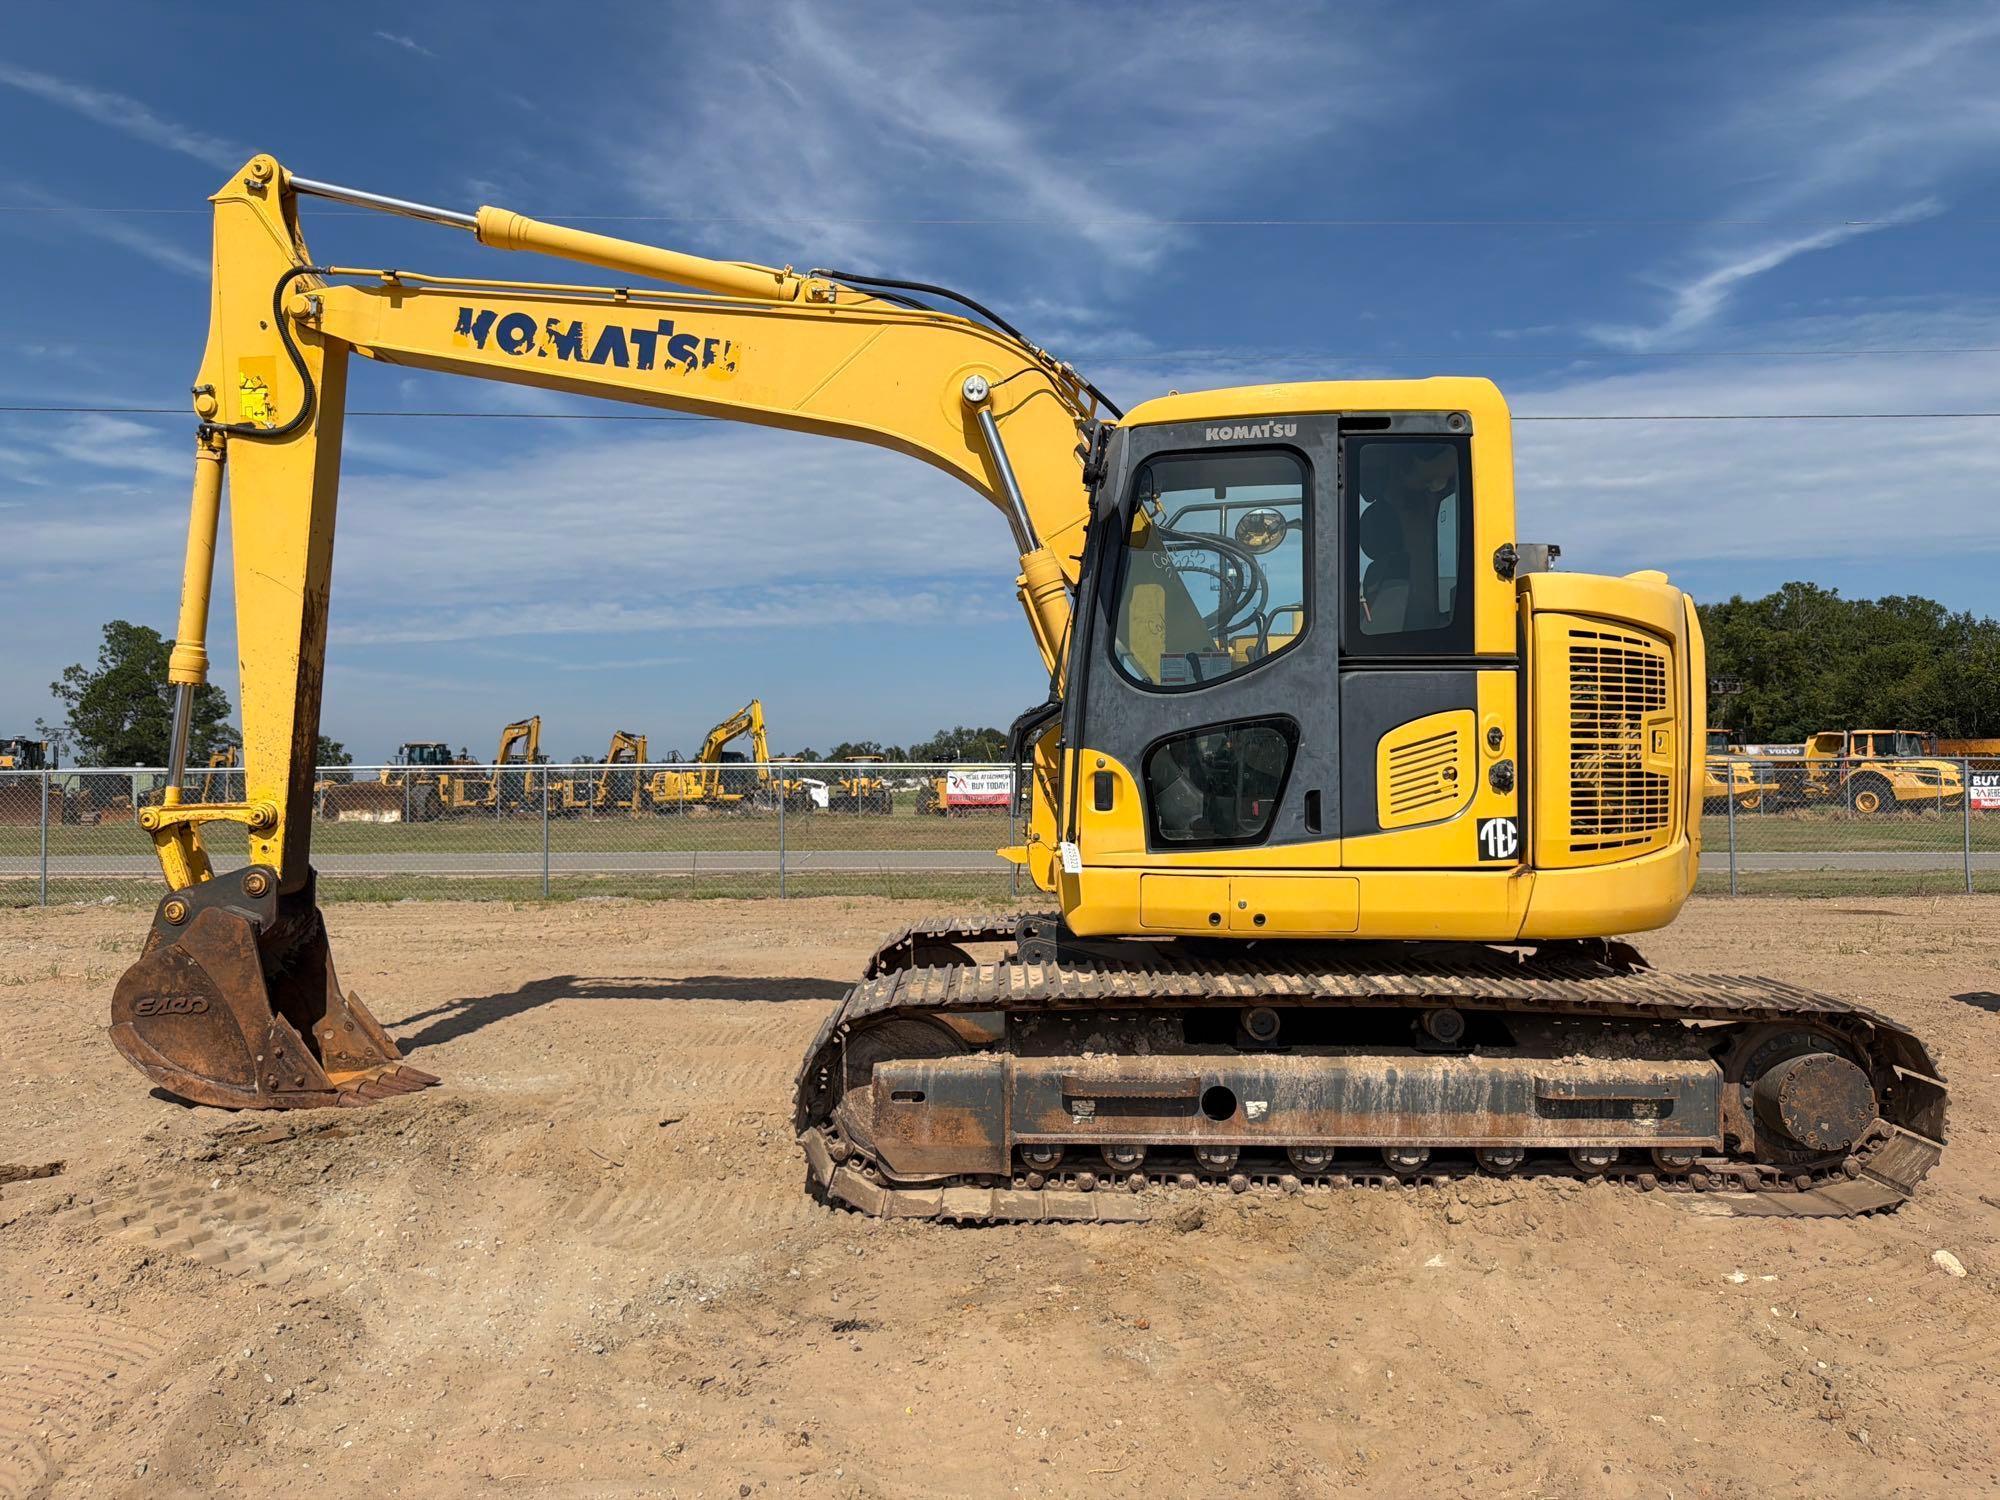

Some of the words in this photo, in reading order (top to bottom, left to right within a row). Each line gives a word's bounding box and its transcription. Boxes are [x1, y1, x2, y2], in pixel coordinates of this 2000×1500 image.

[1205, 420, 1297, 441] KOMATSU
[971, 781, 984, 790] BUY
[987, 781, 1009, 790] TODAY!
[1972, 776, 2000, 786] BUY
